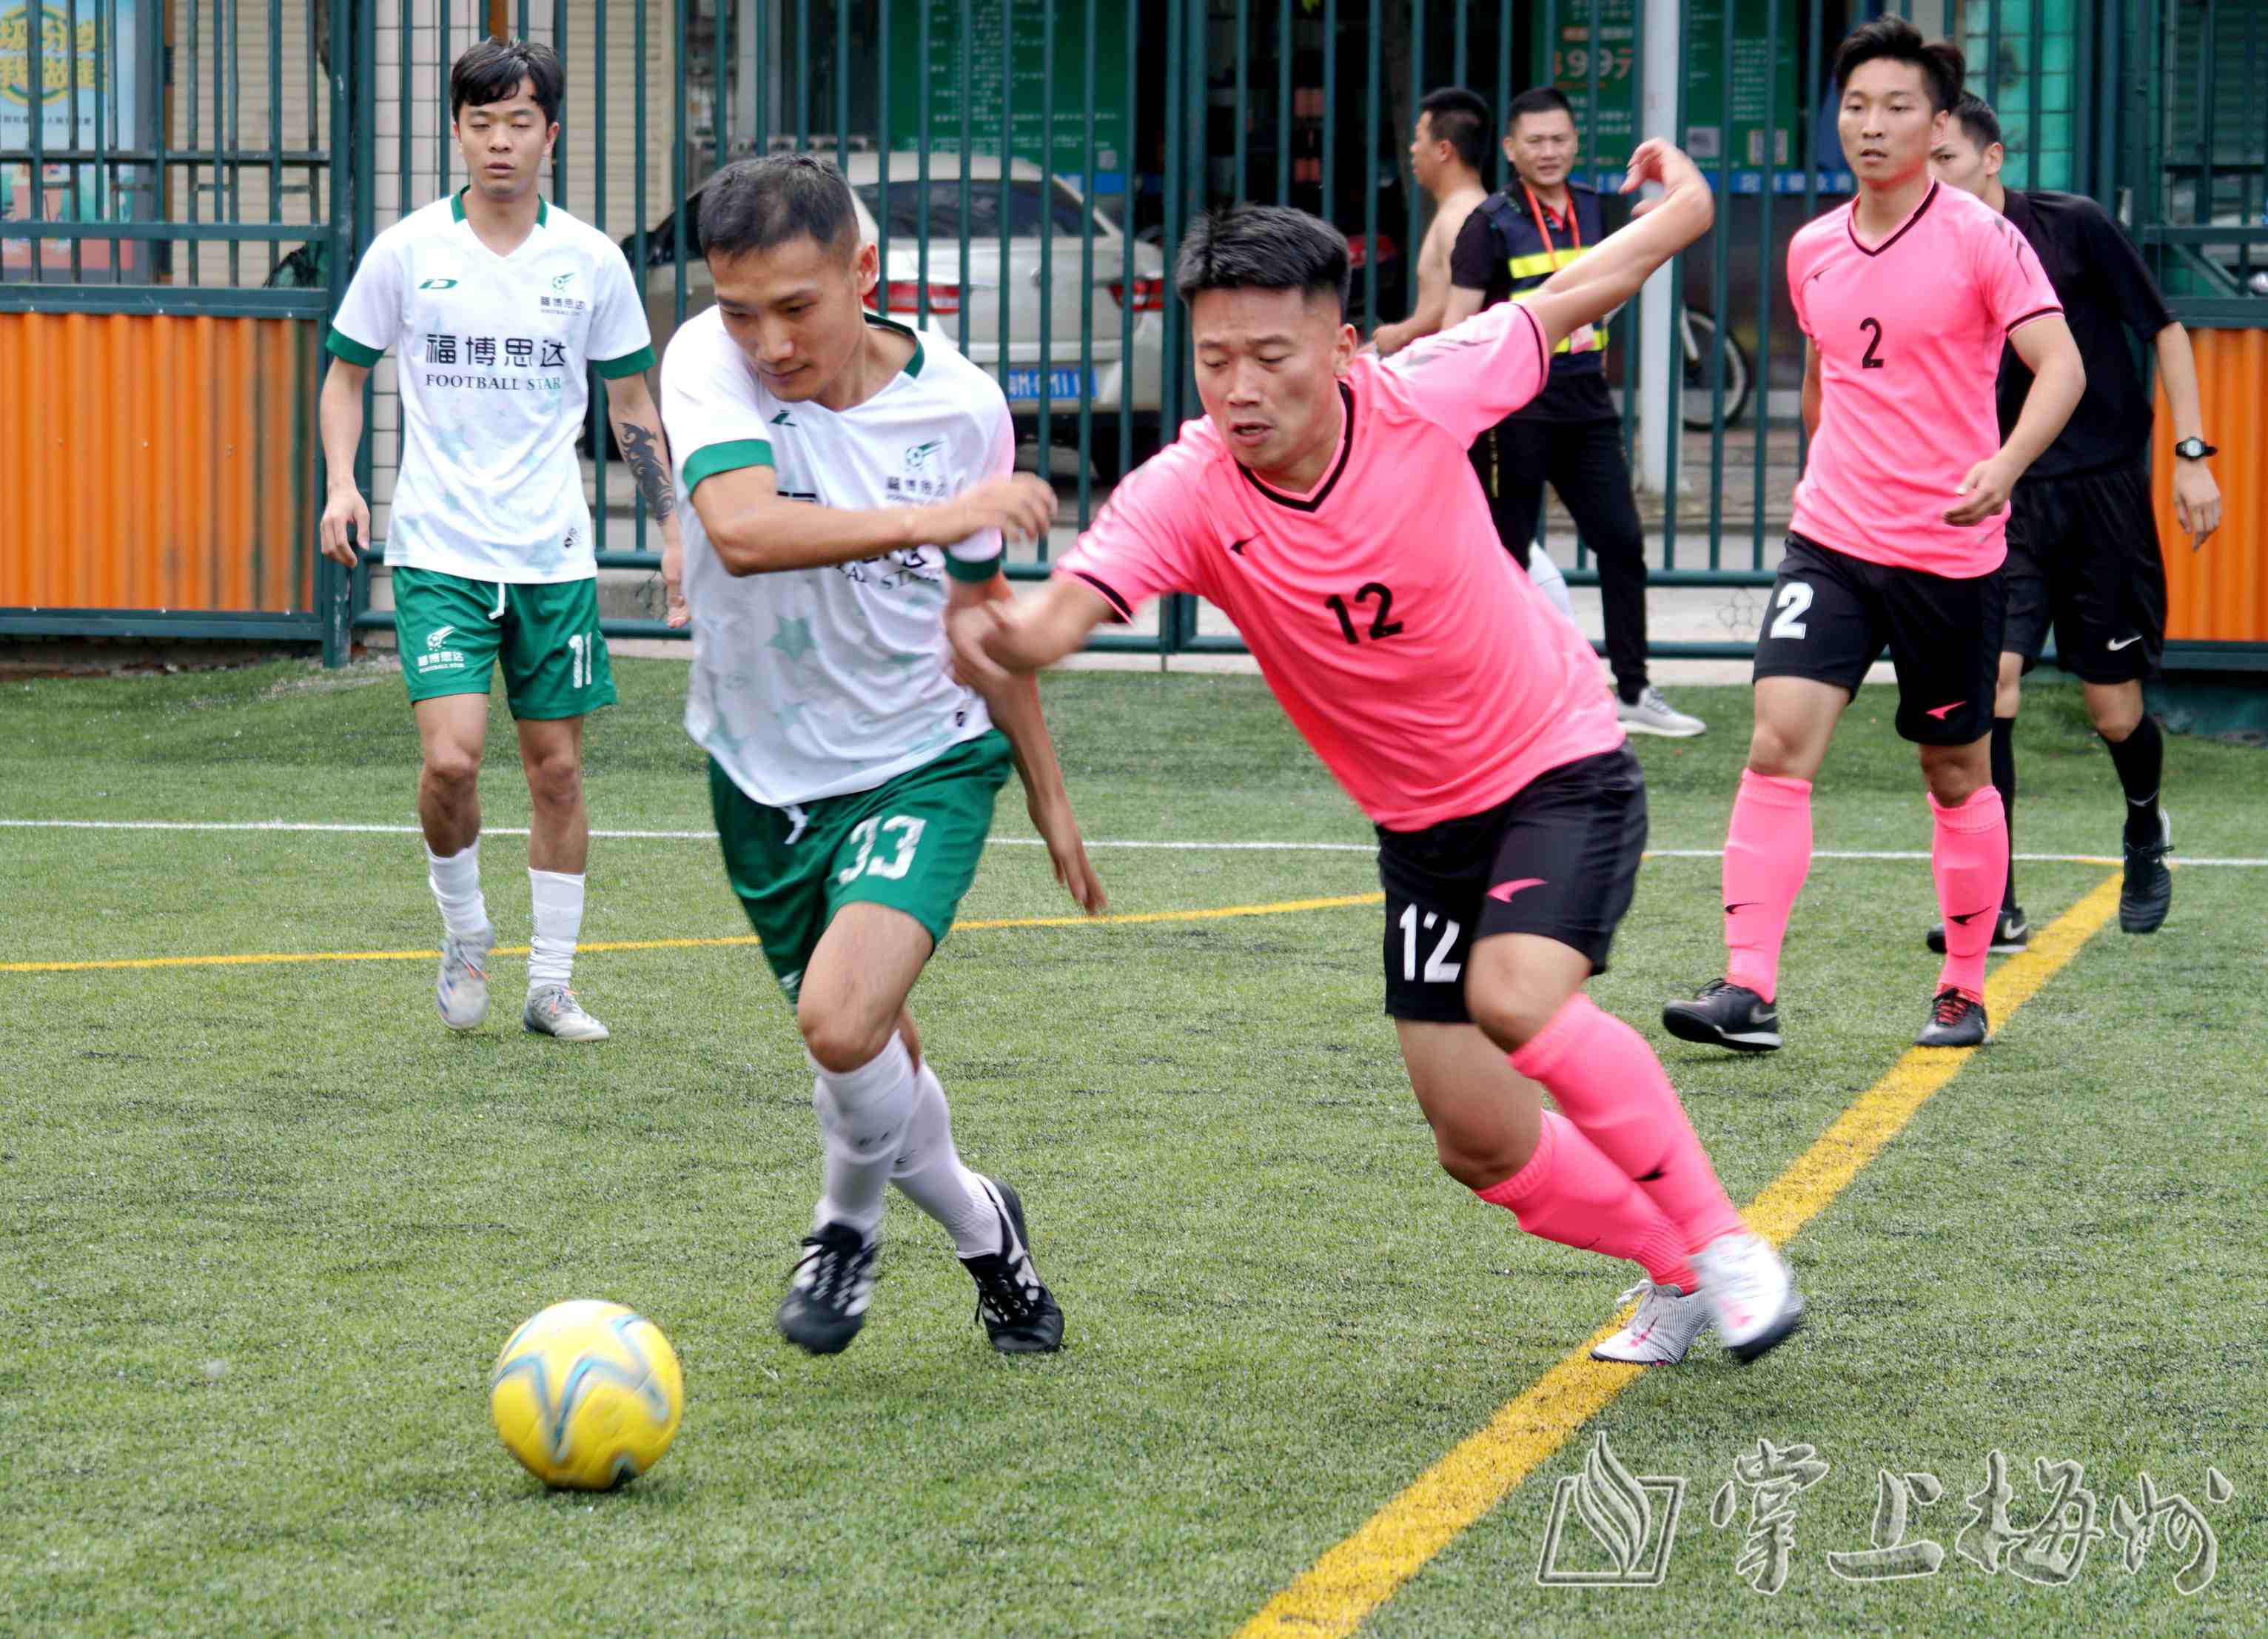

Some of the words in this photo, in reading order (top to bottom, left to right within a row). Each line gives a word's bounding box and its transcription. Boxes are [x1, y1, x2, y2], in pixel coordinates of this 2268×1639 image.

[426, 333, 566, 368] 福博思达
[1859, 317, 1885, 369] 2
[426, 373, 520, 390] FOOTBALL
[526, 377, 562, 391] STAR
[1325, 581, 1404, 645] 12
[1770, 582, 1814, 640] 2
[568, 631, 593, 688] 11
[838, 815, 927, 885] 33
[1399, 902, 1462, 982] 12
